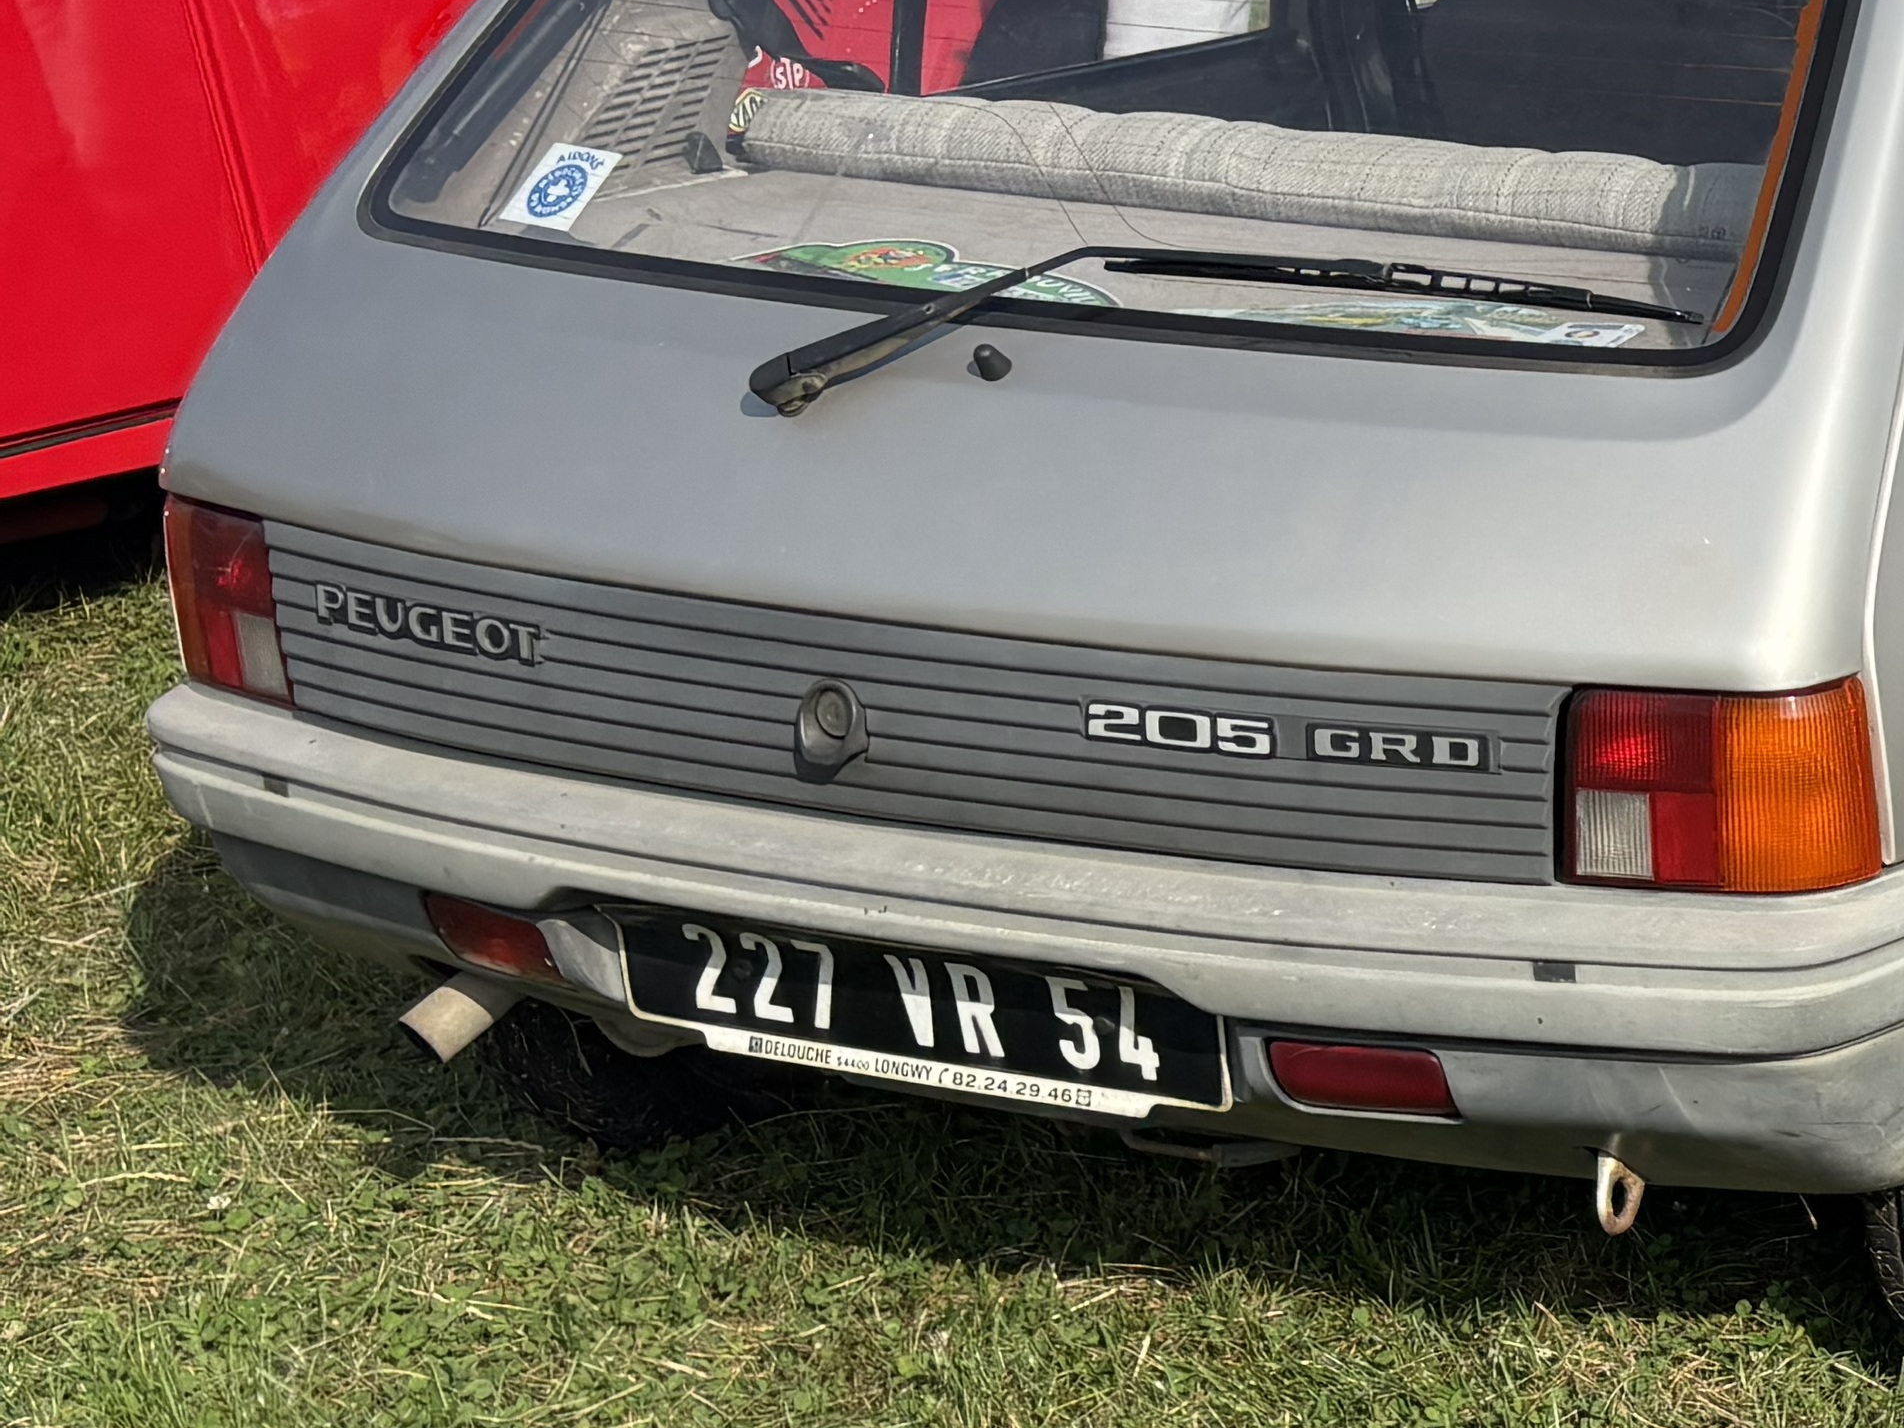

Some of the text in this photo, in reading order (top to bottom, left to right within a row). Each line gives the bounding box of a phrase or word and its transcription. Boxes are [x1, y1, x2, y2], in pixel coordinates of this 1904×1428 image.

[314, 583, 545, 665] PEUGEOT
[1086, 700, 1480, 769] 205 GRD
[681, 923, 1160, 1082] 227 VR 54
[764, 1039, 832, 1065] DELOUCHE
[874, 1057, 932, 1081] LONGWY
